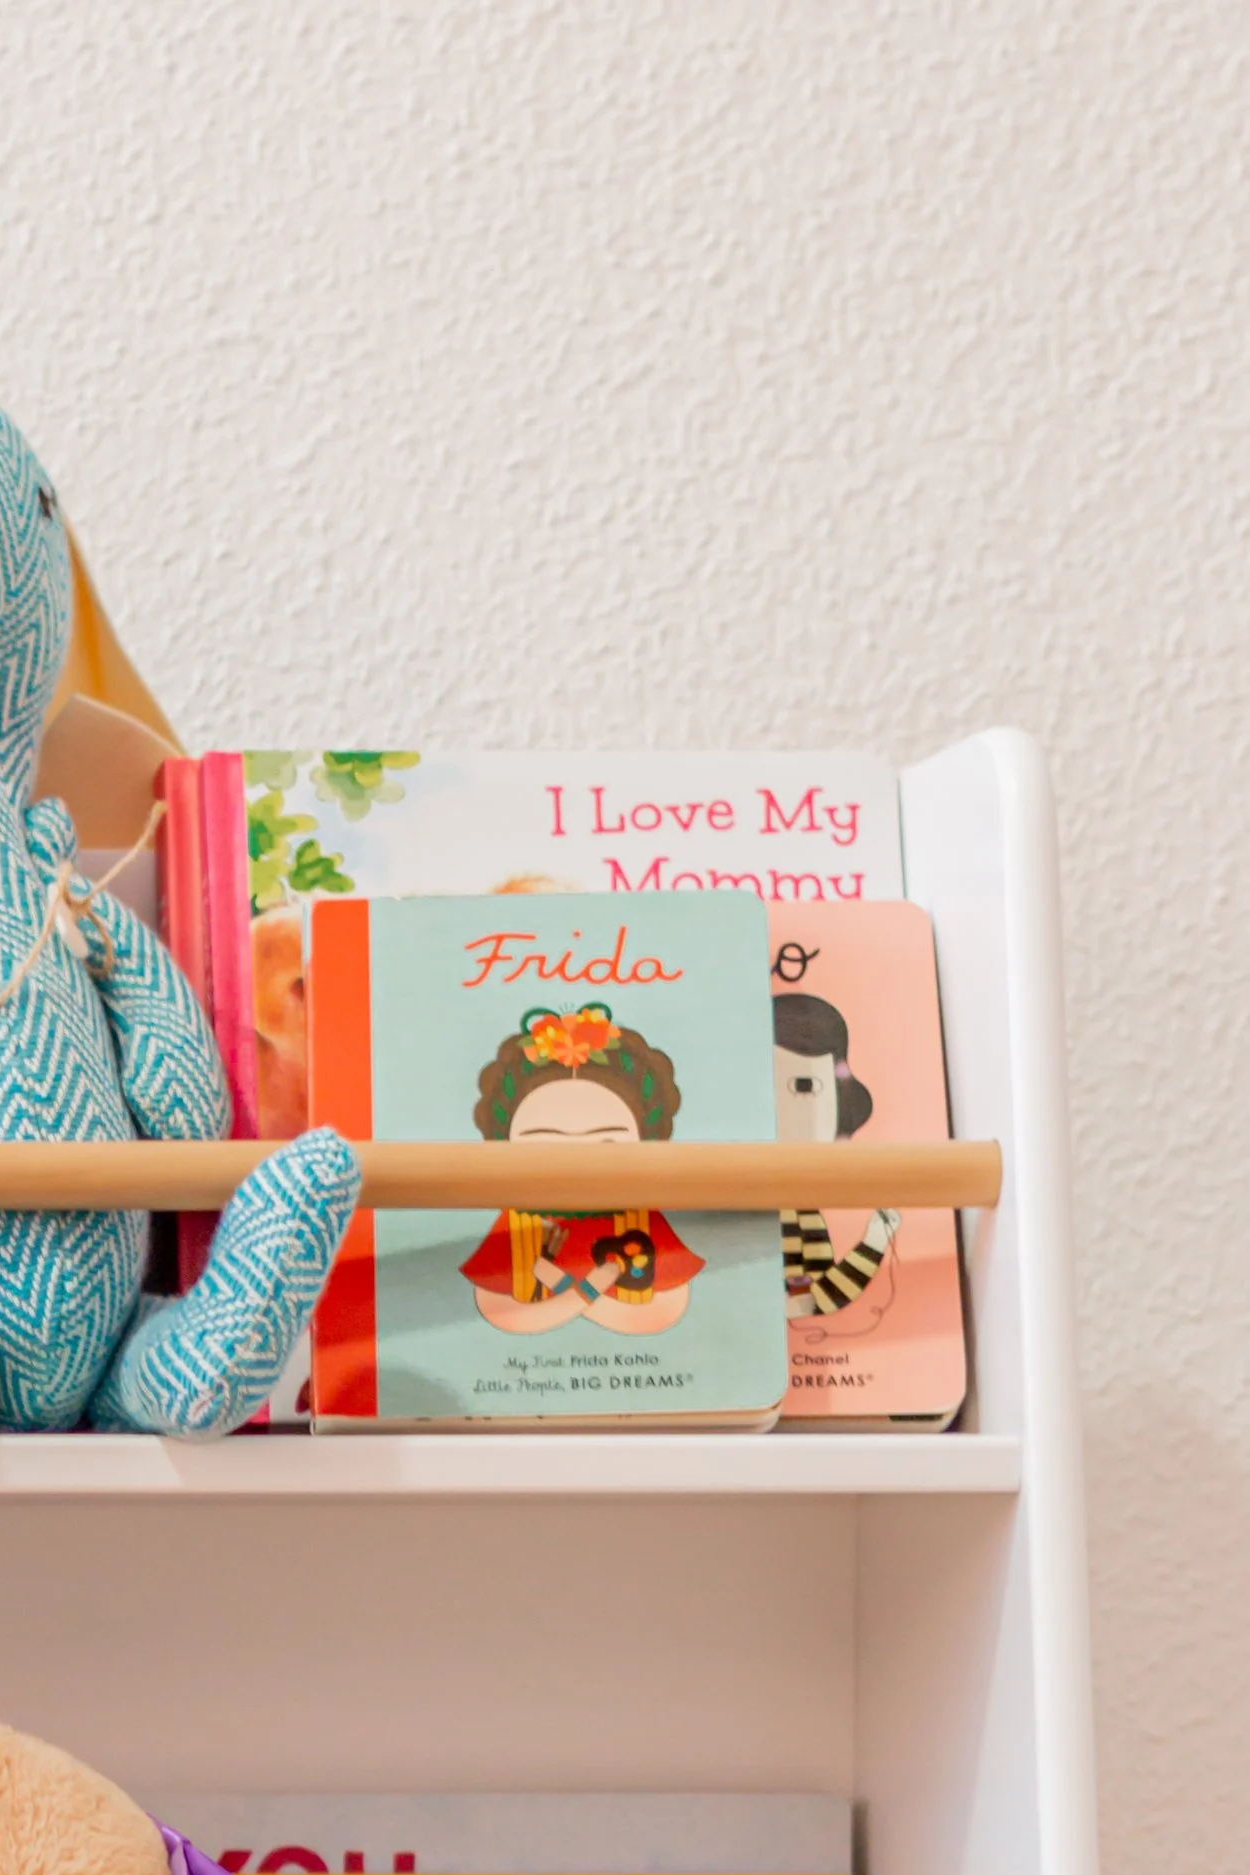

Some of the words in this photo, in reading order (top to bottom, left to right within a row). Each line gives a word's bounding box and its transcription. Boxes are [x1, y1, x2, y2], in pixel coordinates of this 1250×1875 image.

[545, 785, 566, 836] I
[589, 786, 734, 834] Love
[756, 787, 860, 845] My
[461, 925, 684, 987] Frida
[613, 1353, 659, 1366] Kahlo
[791, 1353, 850, 1366] Chanel
[570, 1376, 601, 1390] BIG
